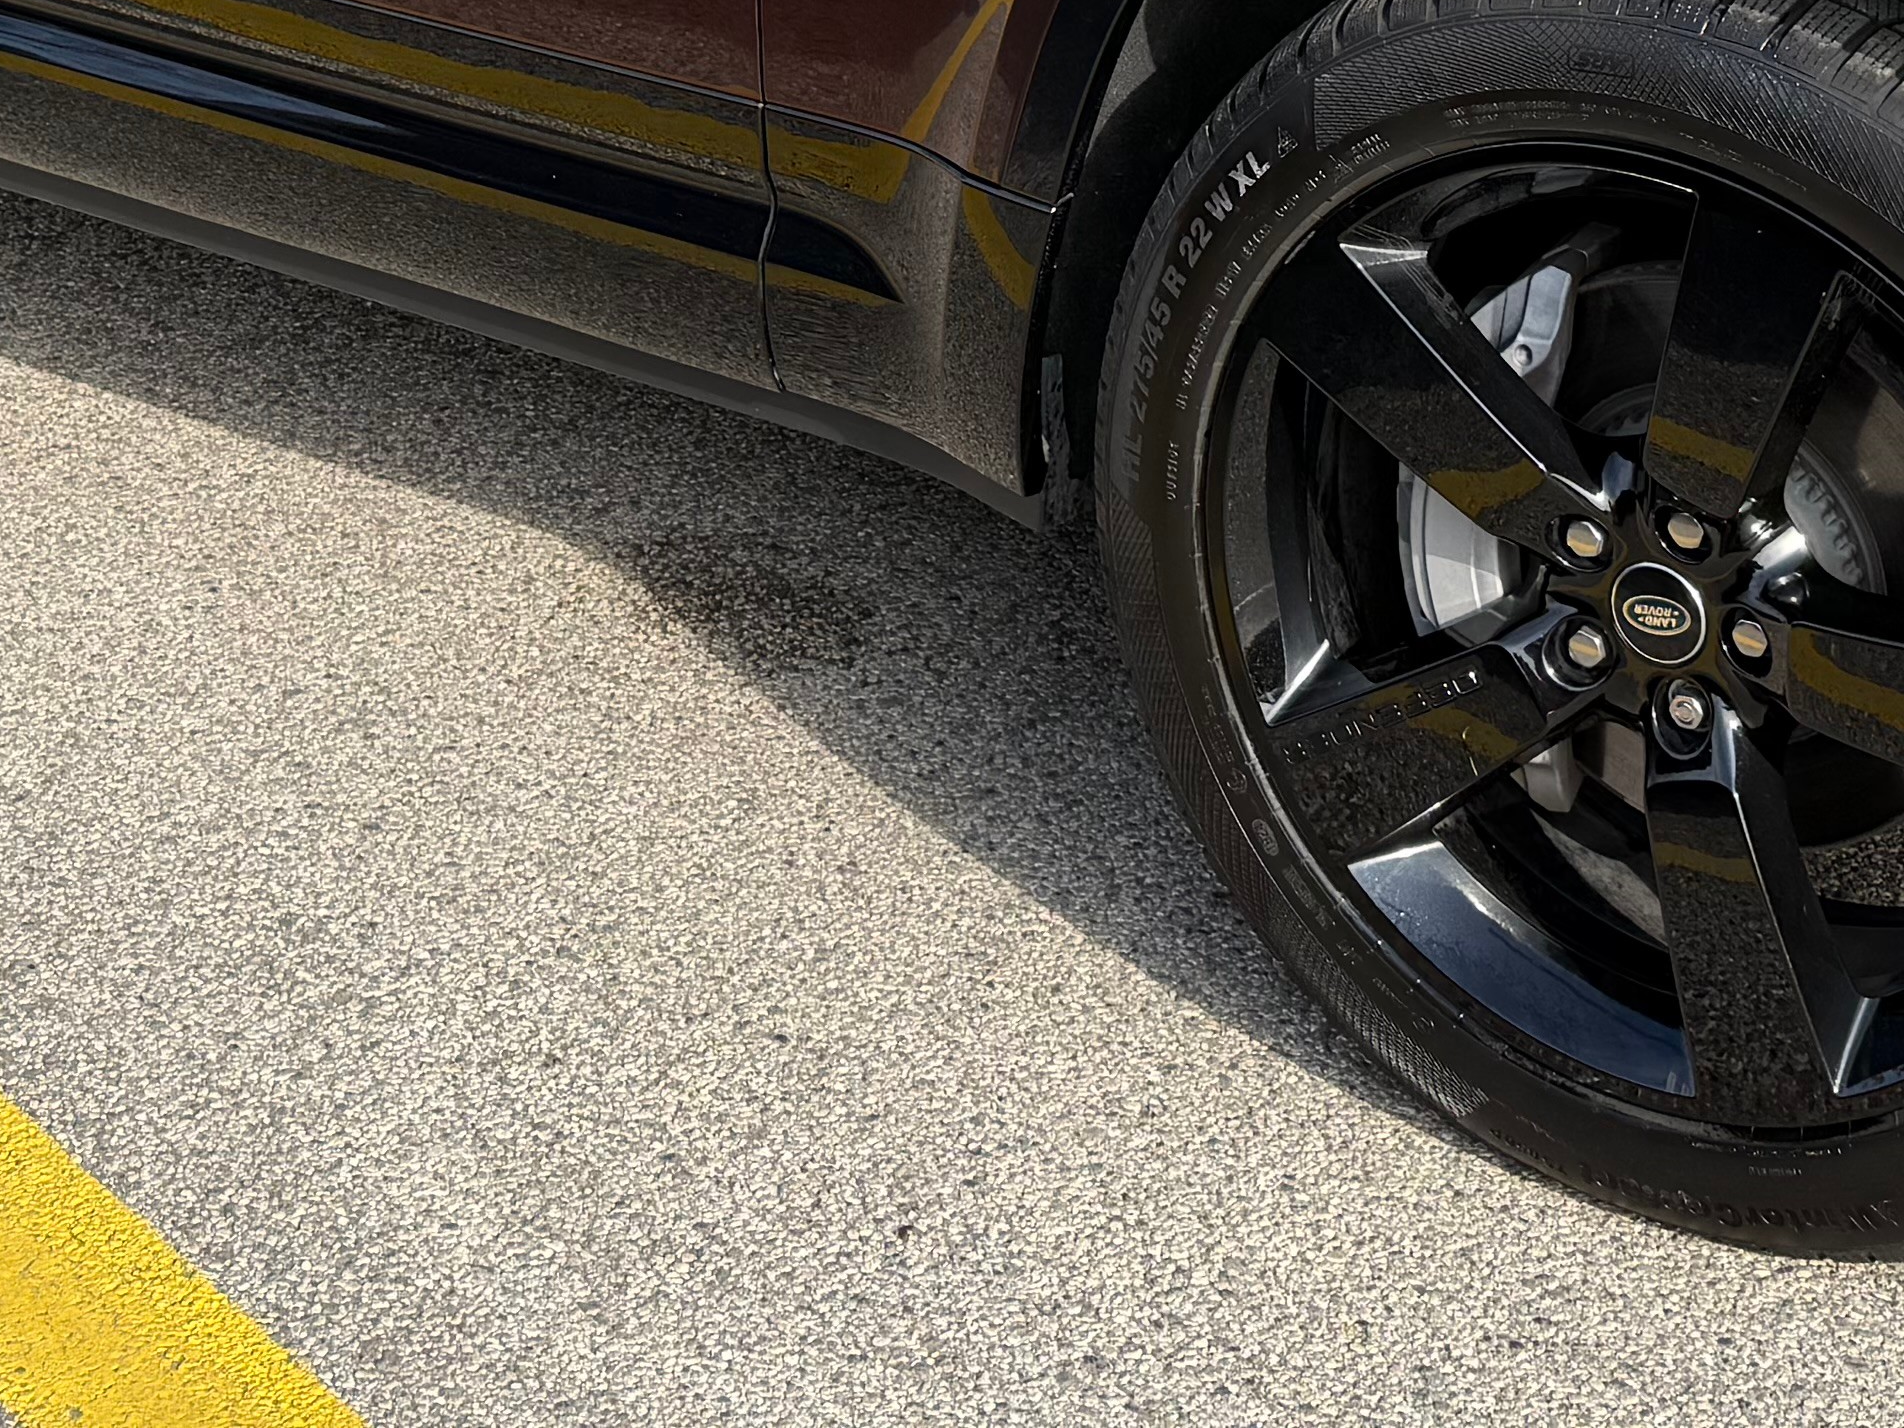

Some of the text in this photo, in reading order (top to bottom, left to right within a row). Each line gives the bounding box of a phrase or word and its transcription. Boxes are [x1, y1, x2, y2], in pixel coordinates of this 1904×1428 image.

[1129, 295, 1172, 424] 275/45
[1161, 263, 1188, 300] R
[1178, 218, 1214, 270] 22
[1204, 182, 1236, 223] W
[1227, 150, 1272, 198] XL
[1633, 603, 1673, 618] ROVER
[1644, 615, 1677, 628] LAND
